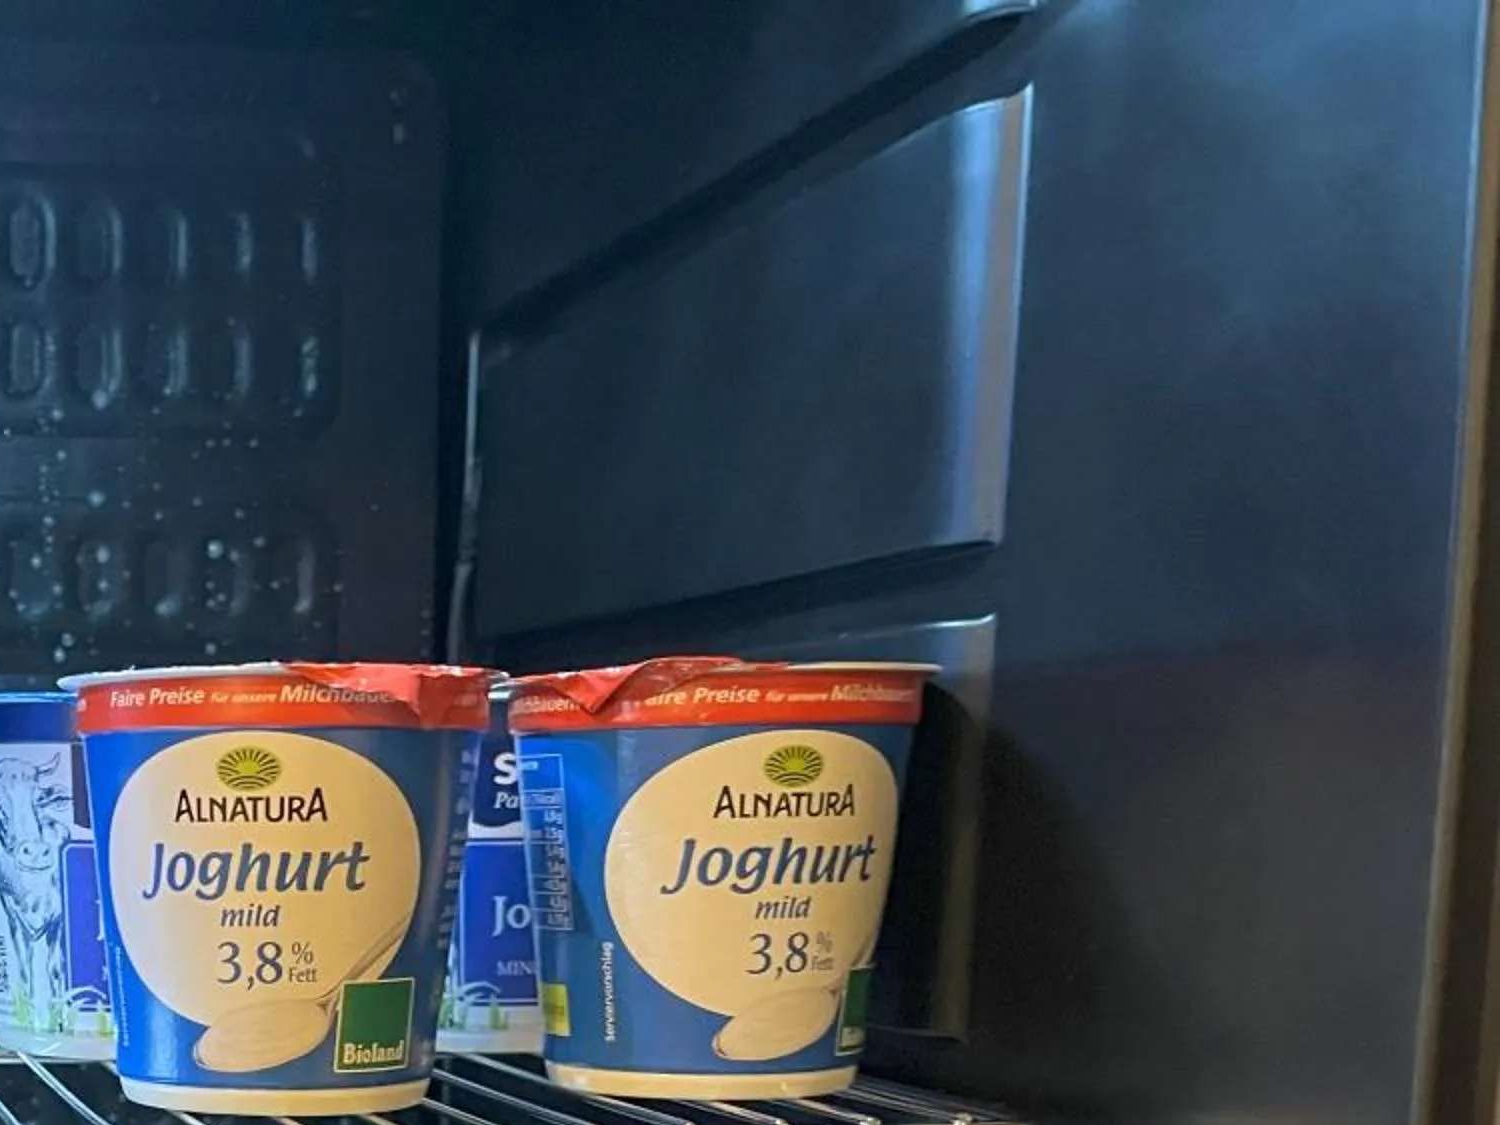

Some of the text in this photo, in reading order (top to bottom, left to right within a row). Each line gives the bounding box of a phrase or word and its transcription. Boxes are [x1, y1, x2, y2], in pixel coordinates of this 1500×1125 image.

[110, 690, 145, 709] Faire
[149, 685, 205, 706] Preise
[693, 686, 760, 706] Preise
[175, 787, 329, 823] ALNATURA
[712, 784, 856, 819] ALNATURA
[142, 841, 371, 900] Joghurt
[659, 835, 878, 896] Joghurt
[219, 904, 282, 928] mild
[754, 896, 812, 921] mild
[216, 940, 314, 991] 3,8 %
[744, 931, 810, 981] 3,8
[288, 967, 319, 983] Fett
[342, 1039, 405, 1065] Bioland
